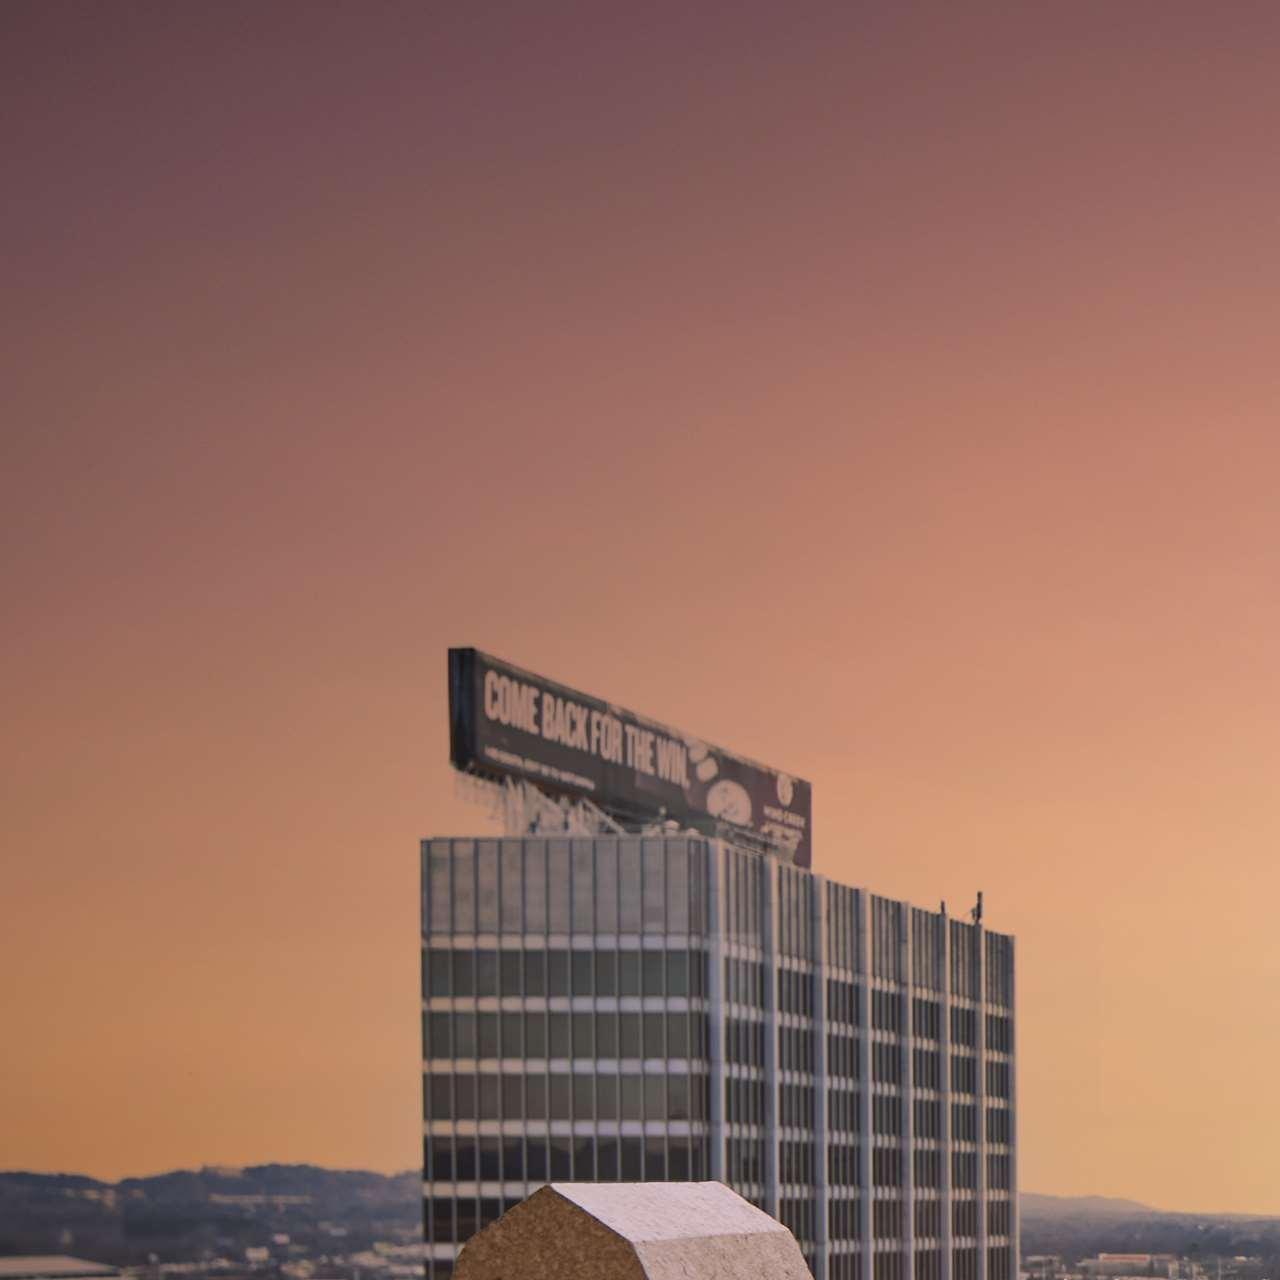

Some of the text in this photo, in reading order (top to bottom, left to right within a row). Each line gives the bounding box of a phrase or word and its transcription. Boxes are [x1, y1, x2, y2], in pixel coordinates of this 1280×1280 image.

[484, 670, 540, 735] COME
[542, 691, 589, 752] BACK
[590, 709, 623, 766] FOR
[624, 723, 656, 776] THE
[656, 736, 691, 790] WIN.
